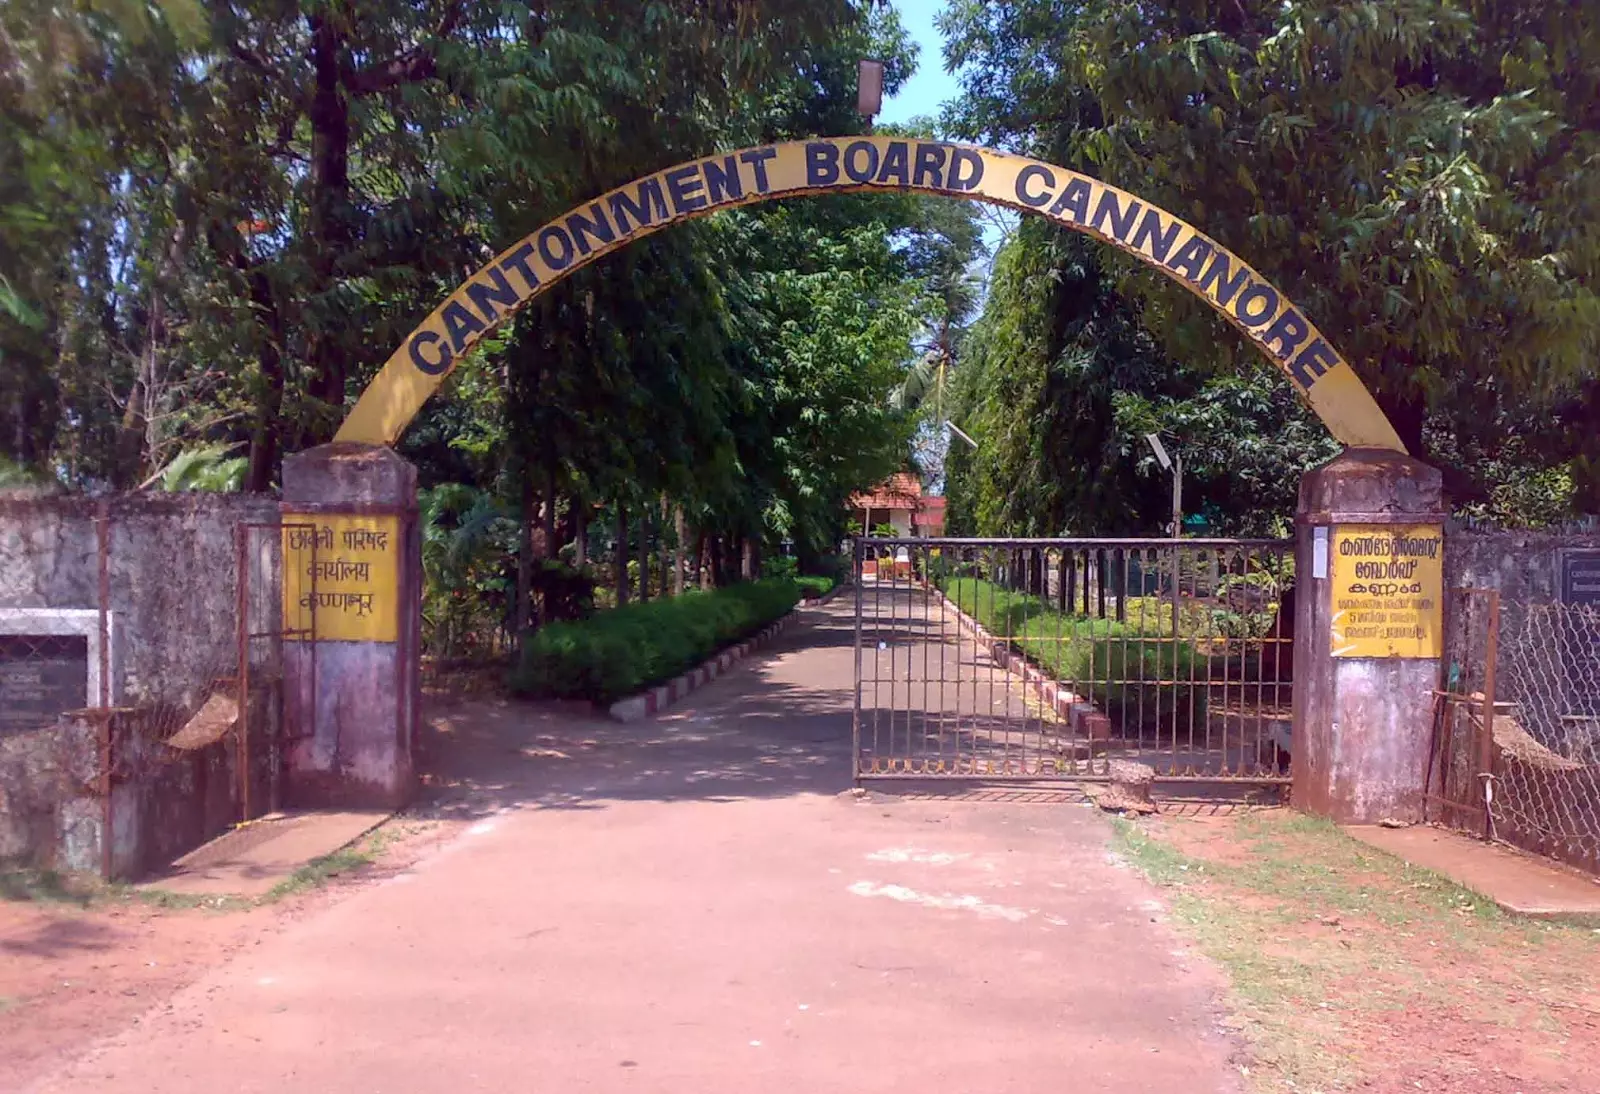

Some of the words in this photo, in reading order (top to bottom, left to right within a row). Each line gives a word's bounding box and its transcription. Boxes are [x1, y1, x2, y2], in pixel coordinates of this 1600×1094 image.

[407, 147, 777, 376] CANTONMENT
[805, 140, 985, 191] BOARD
[1015, 164, 1341, 391] CANNANORE
[342, 529, 388, 550] परिषद
[307, 557, 370, 582] कार्यालय
